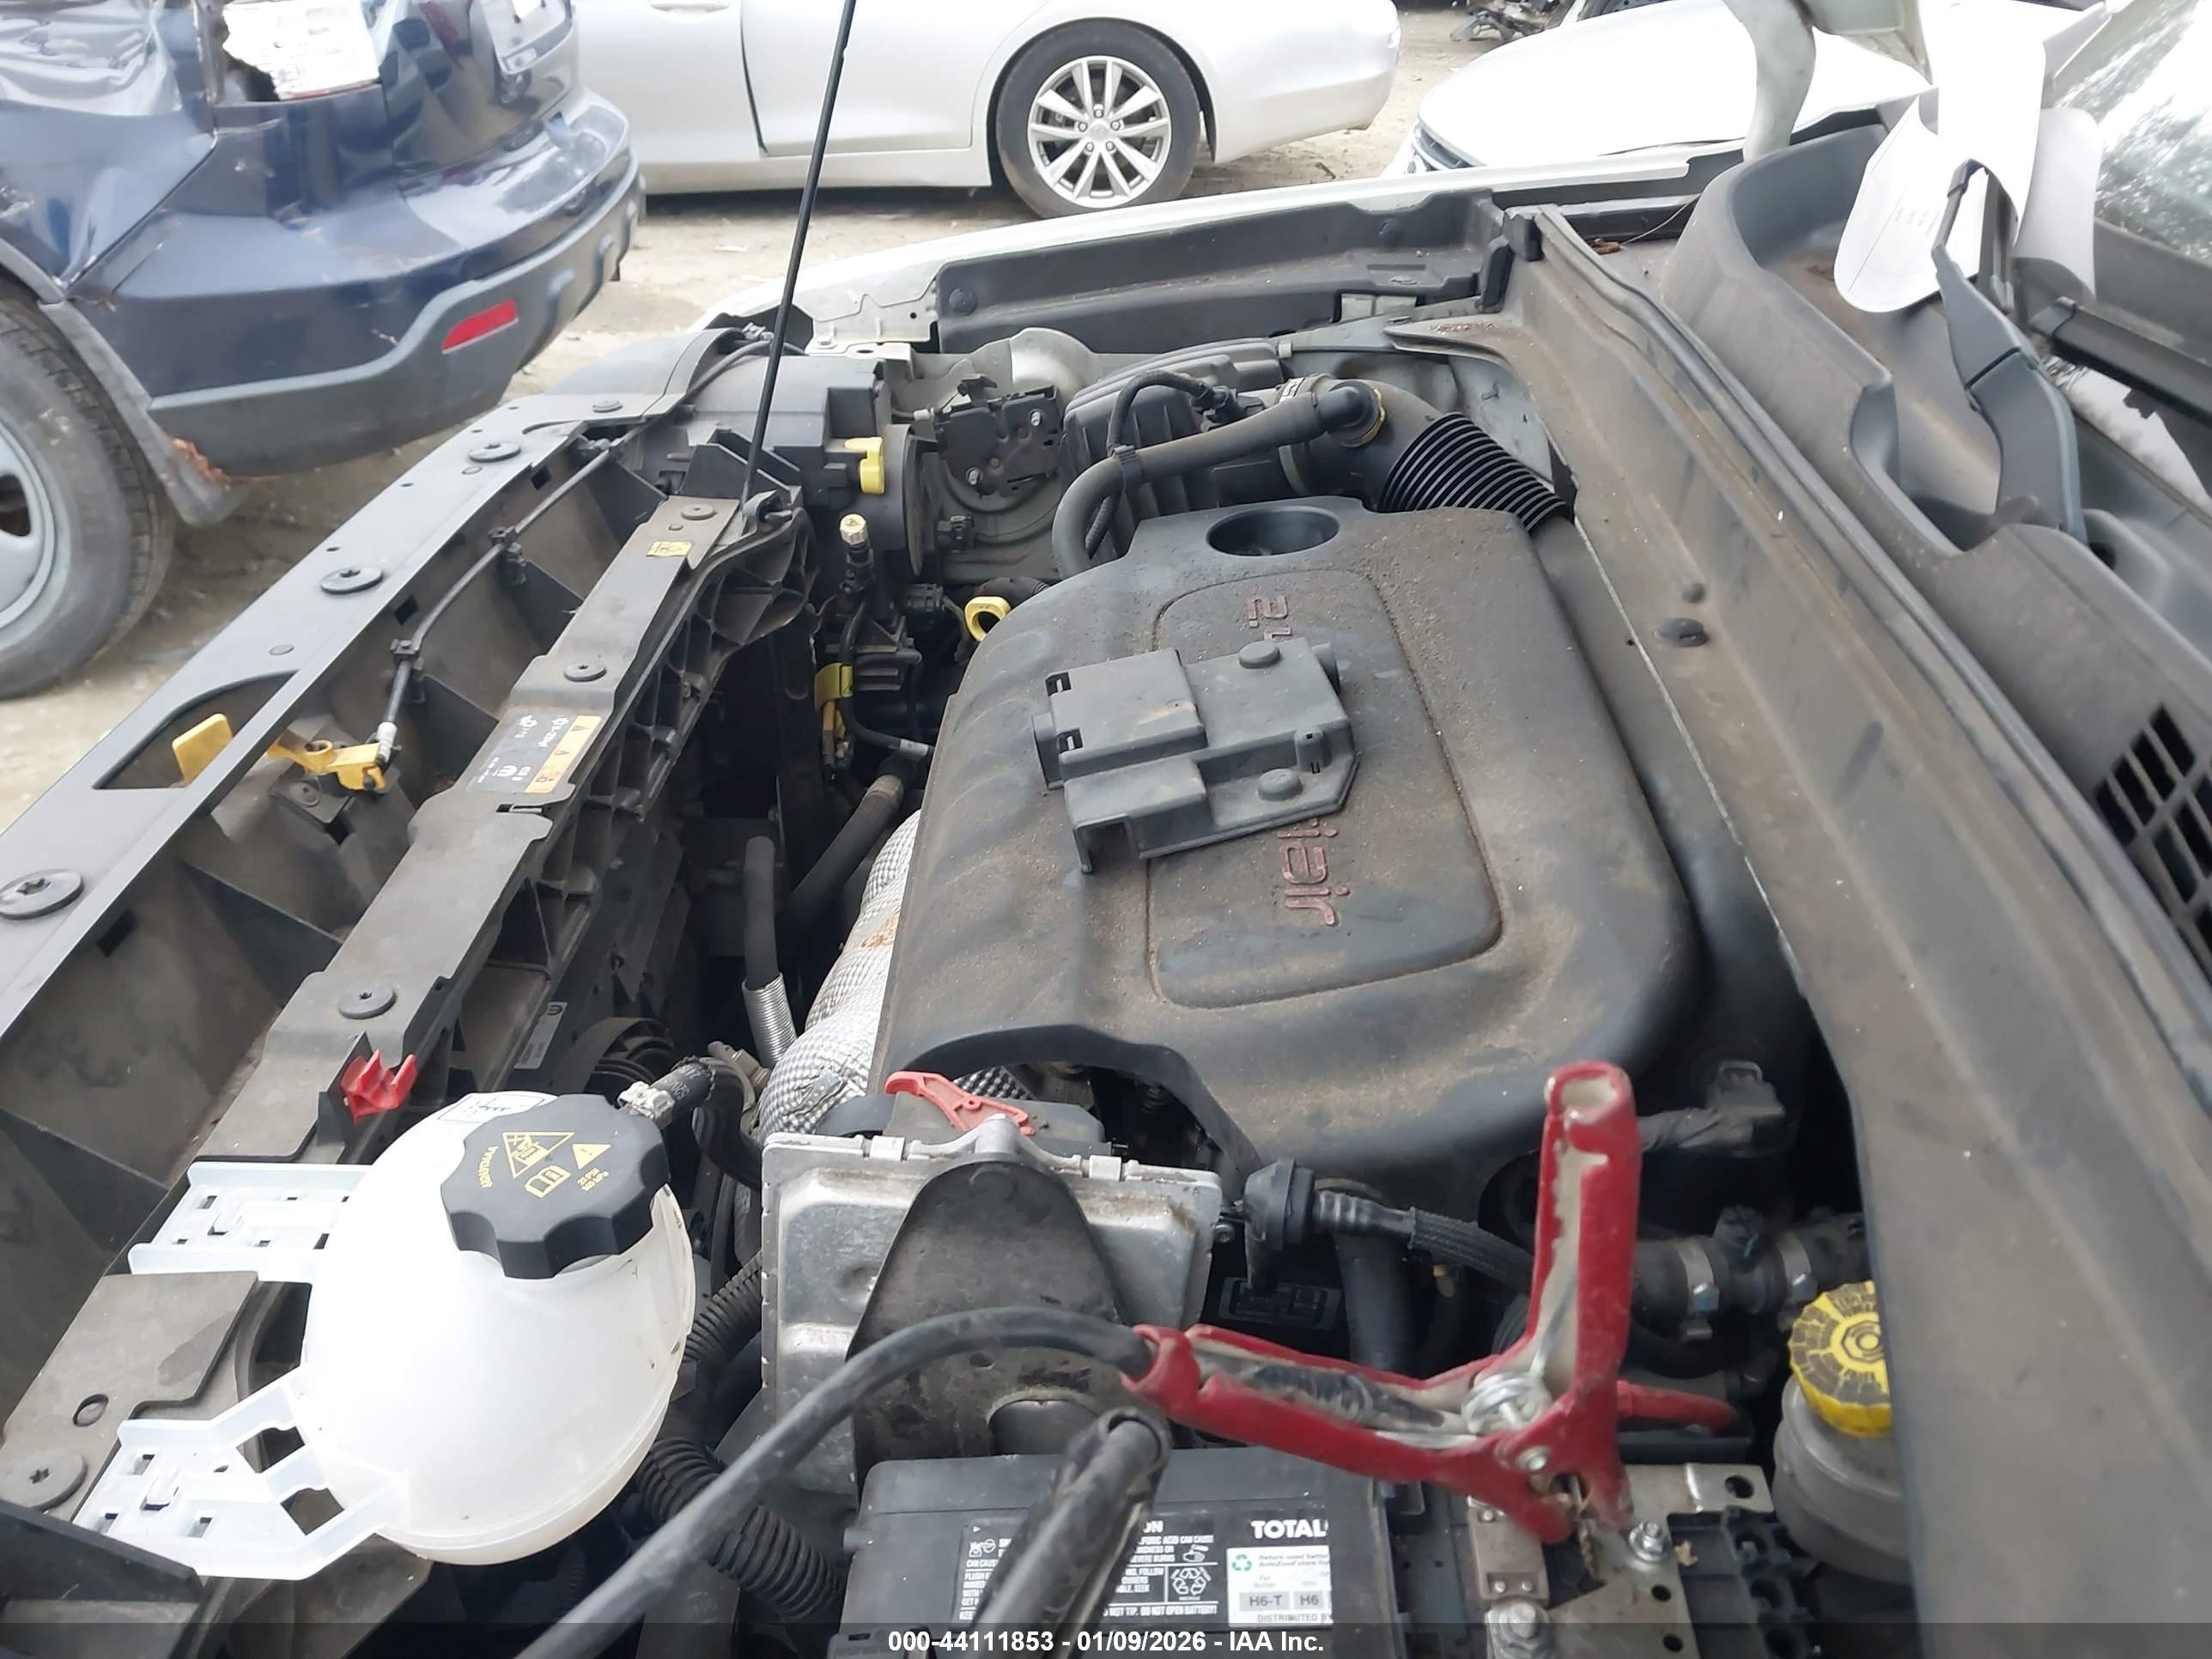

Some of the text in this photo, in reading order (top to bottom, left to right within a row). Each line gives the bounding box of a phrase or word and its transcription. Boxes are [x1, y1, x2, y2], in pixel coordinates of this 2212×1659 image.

[1250, 1519, 1327, 1539] TOTAL
[1249, 1595, 1319, 1606] H6-T H6
[1257, 1613, 1318, 1622] DISTRIBUTED
